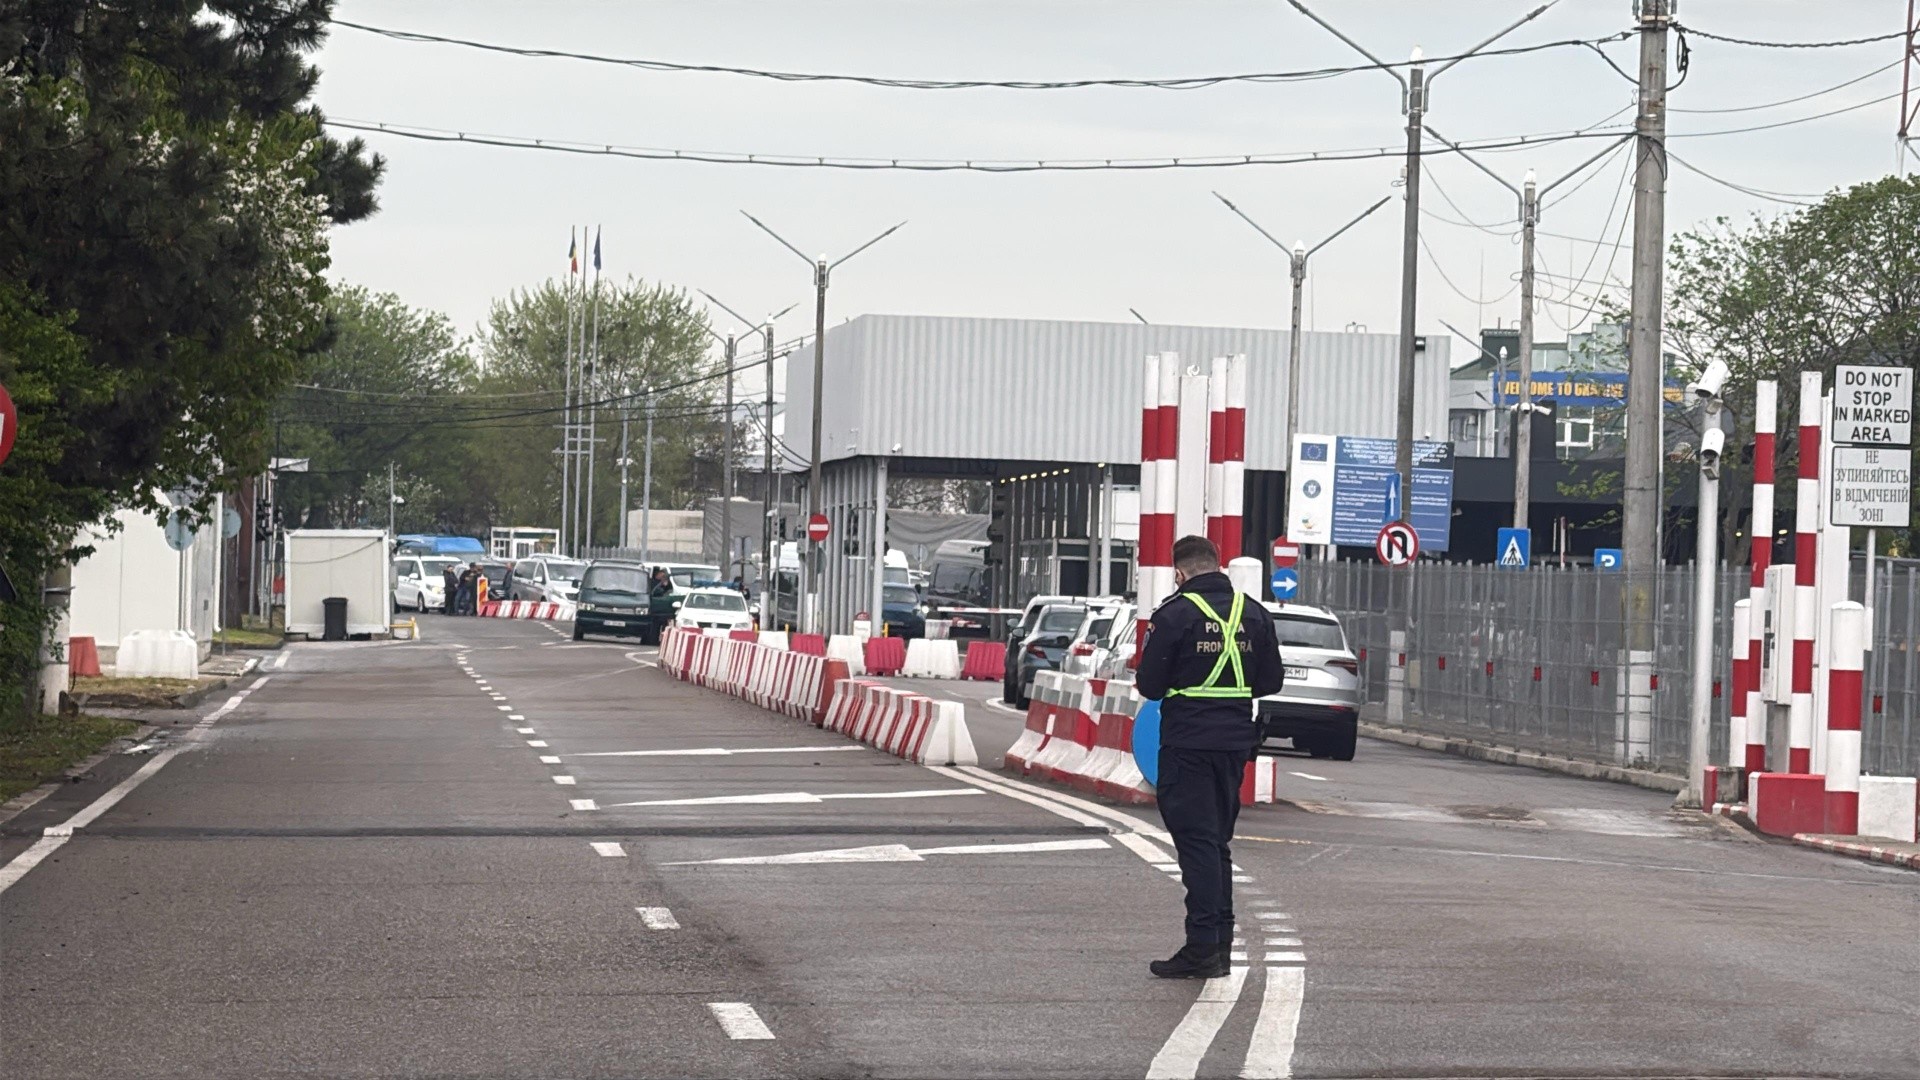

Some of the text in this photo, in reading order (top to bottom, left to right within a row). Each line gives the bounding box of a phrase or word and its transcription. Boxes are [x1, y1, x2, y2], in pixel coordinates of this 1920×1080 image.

[1845, 371, 1901, 387] DO NOT
[1556, 382, 1572, 396] TO
[1853, 390, 1892, 406] STOP
[1834, 406, 1911, 424] IN MARKED
[1851, 426, 1891, 441] AREA
[1865, 450, 1879, 464] НЕ
[1834, 467, 1909, 484] ЗУПИНЯЙТЕСЬ
[1835, 486, 1908, 503] В ВІДМІЧЕНІЙ
[1859, 507, 1883, 522] ЗОНІ
